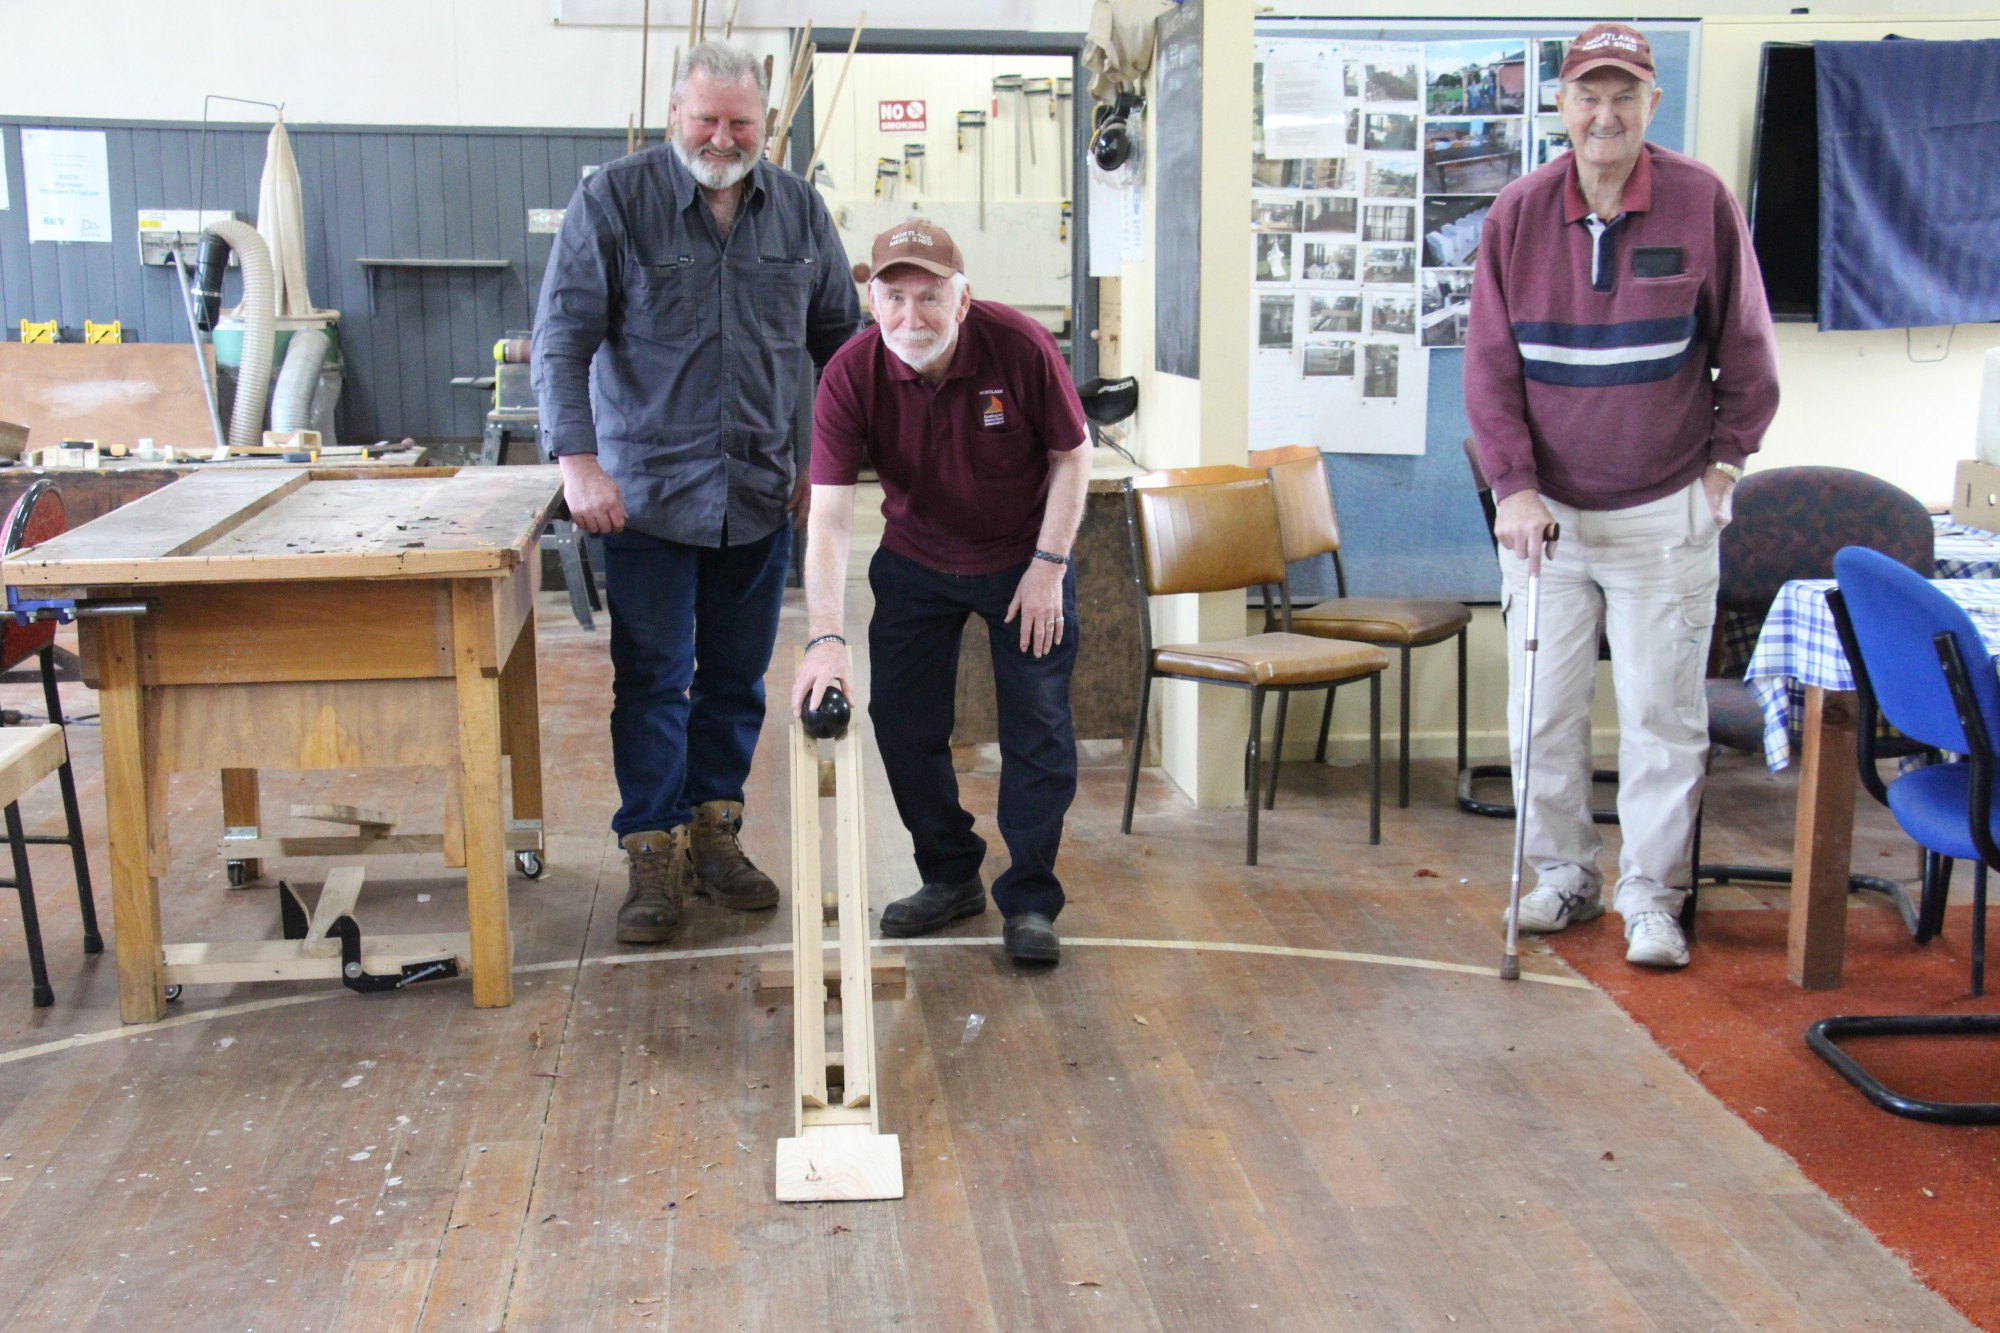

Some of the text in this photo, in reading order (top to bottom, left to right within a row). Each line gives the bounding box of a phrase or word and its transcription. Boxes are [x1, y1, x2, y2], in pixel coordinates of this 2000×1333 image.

[1585, 32, 1637, 45] MORTLAKE
[1613, 41, 1637, 52] SHED
[880, 103, 904, 120] NO
[880, 121, 925, 130] SMOKING
[891, 230, 932, 241] MORTLAKE
[912, 236, 934, 247] SHED
